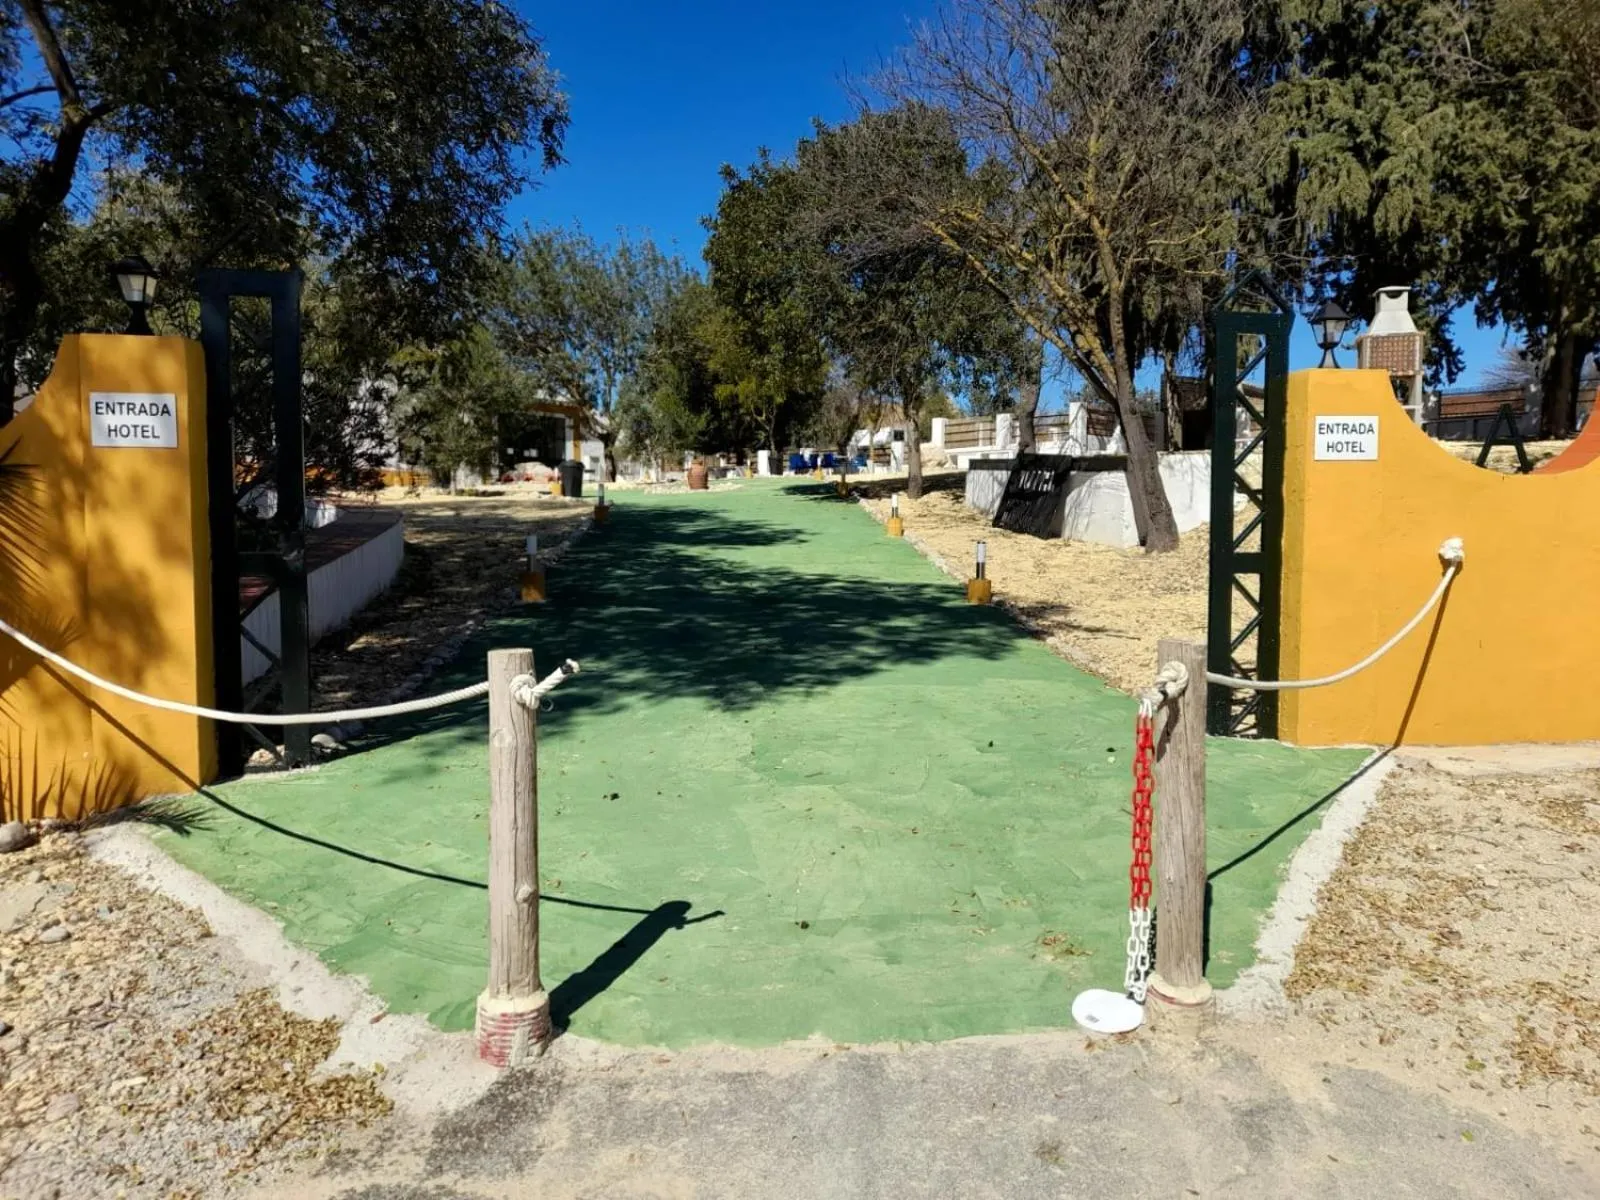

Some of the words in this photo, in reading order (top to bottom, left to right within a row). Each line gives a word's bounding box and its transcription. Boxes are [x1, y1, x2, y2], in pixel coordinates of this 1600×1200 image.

[94, 401, 171, 416] ENTRADA
[107, 424, 160, 439] HOTEL
[1318, 423, 1375, 435] ENTRADA
[1326, 441, 1366, 453] HOTEL
